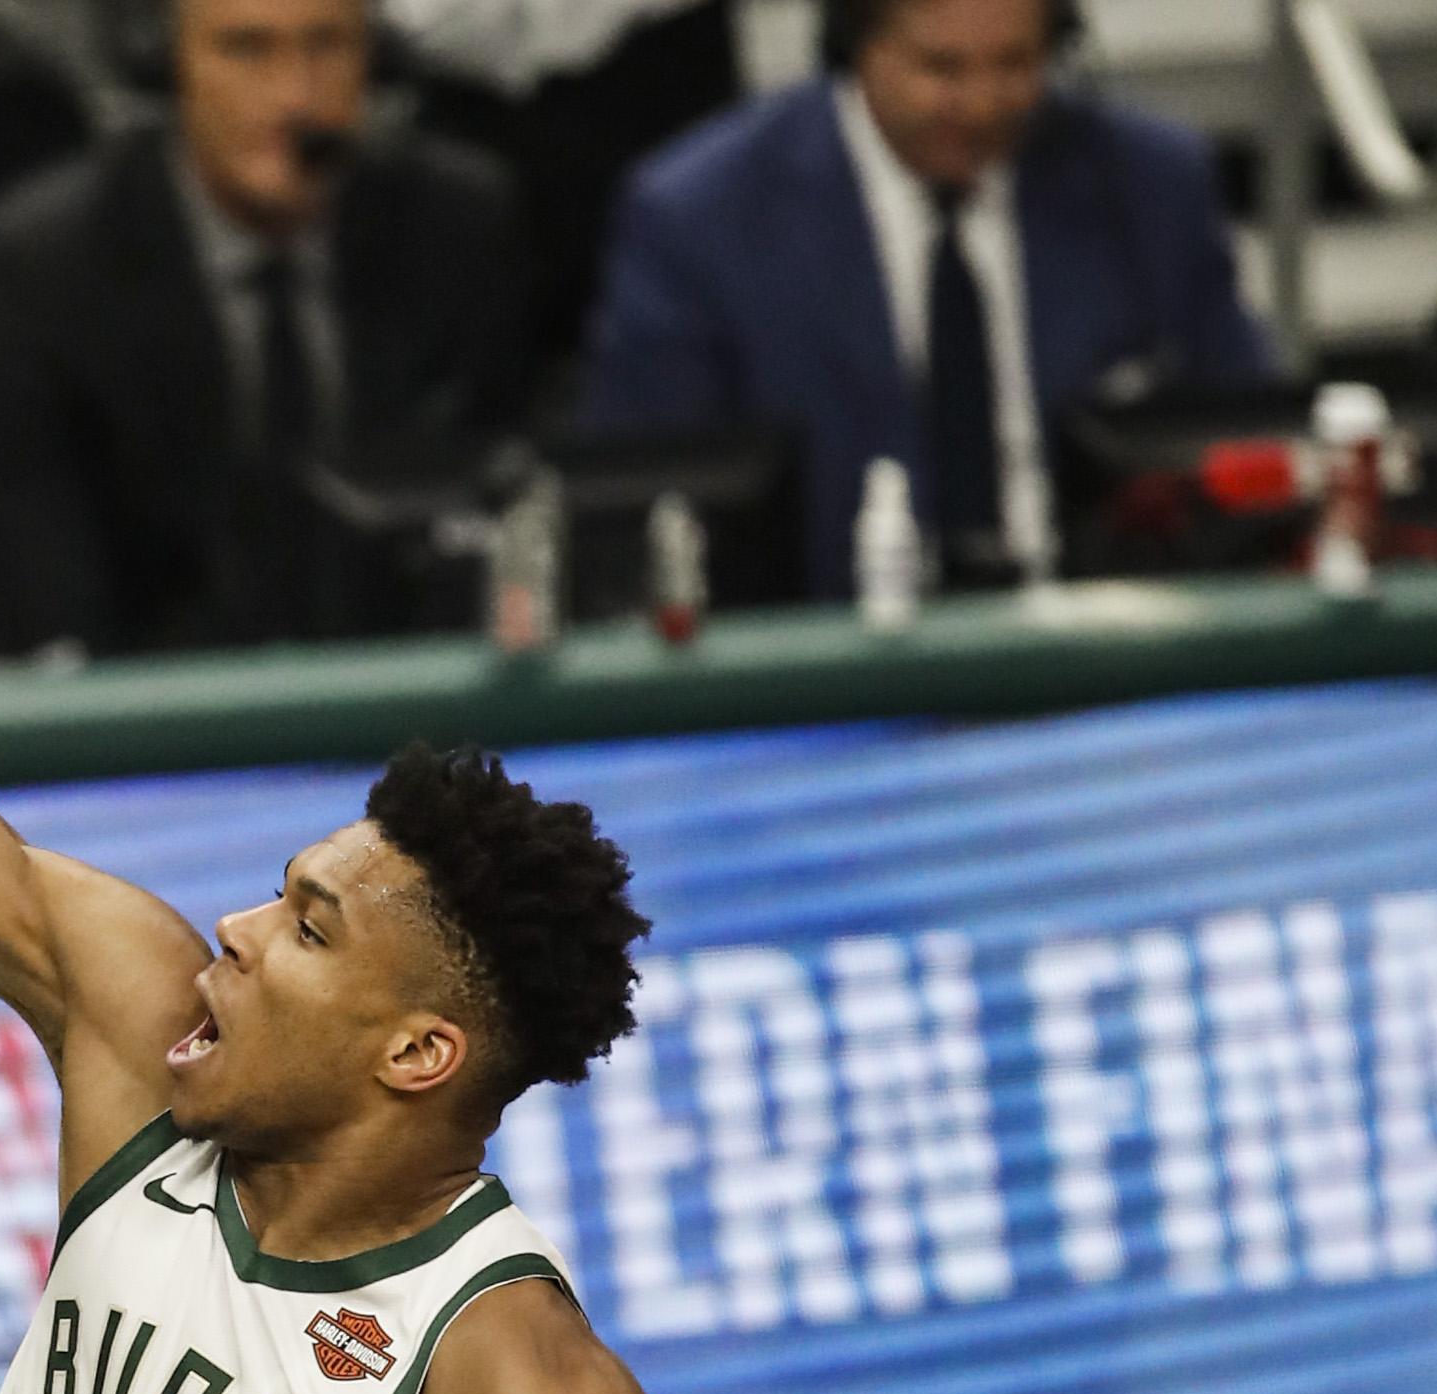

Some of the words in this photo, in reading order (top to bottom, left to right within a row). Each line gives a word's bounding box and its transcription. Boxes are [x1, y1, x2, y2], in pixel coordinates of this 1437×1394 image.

[312, 1318, 390, 1373] HARLEY-DAVIDSON
[342, 1316, 384, 1348] MOTOR
[320, 1346, 361, 1376] CYCLES
